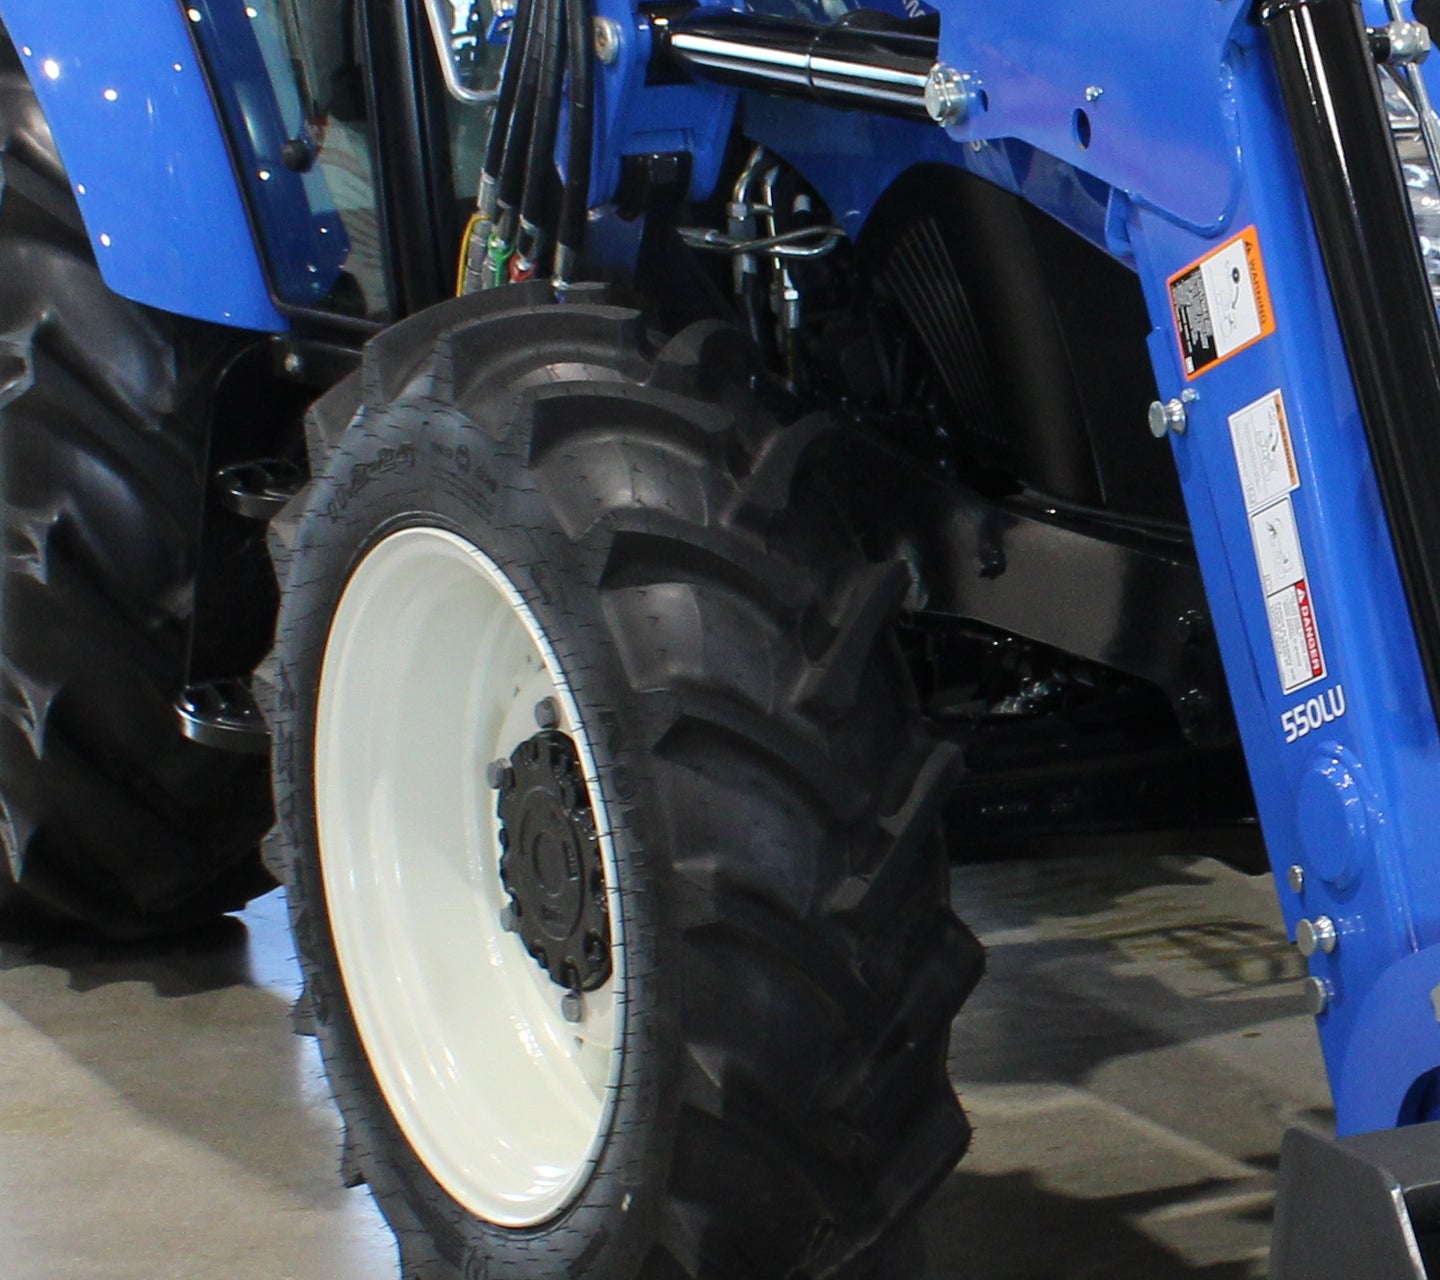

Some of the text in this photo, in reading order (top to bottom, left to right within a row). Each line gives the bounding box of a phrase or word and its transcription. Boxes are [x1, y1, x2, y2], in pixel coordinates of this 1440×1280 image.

[1249, 258, 1267, 325] WARNING
[1299, 604, 1321, 671] DANGER
[1280, 684, 1346, 744] 550LU
